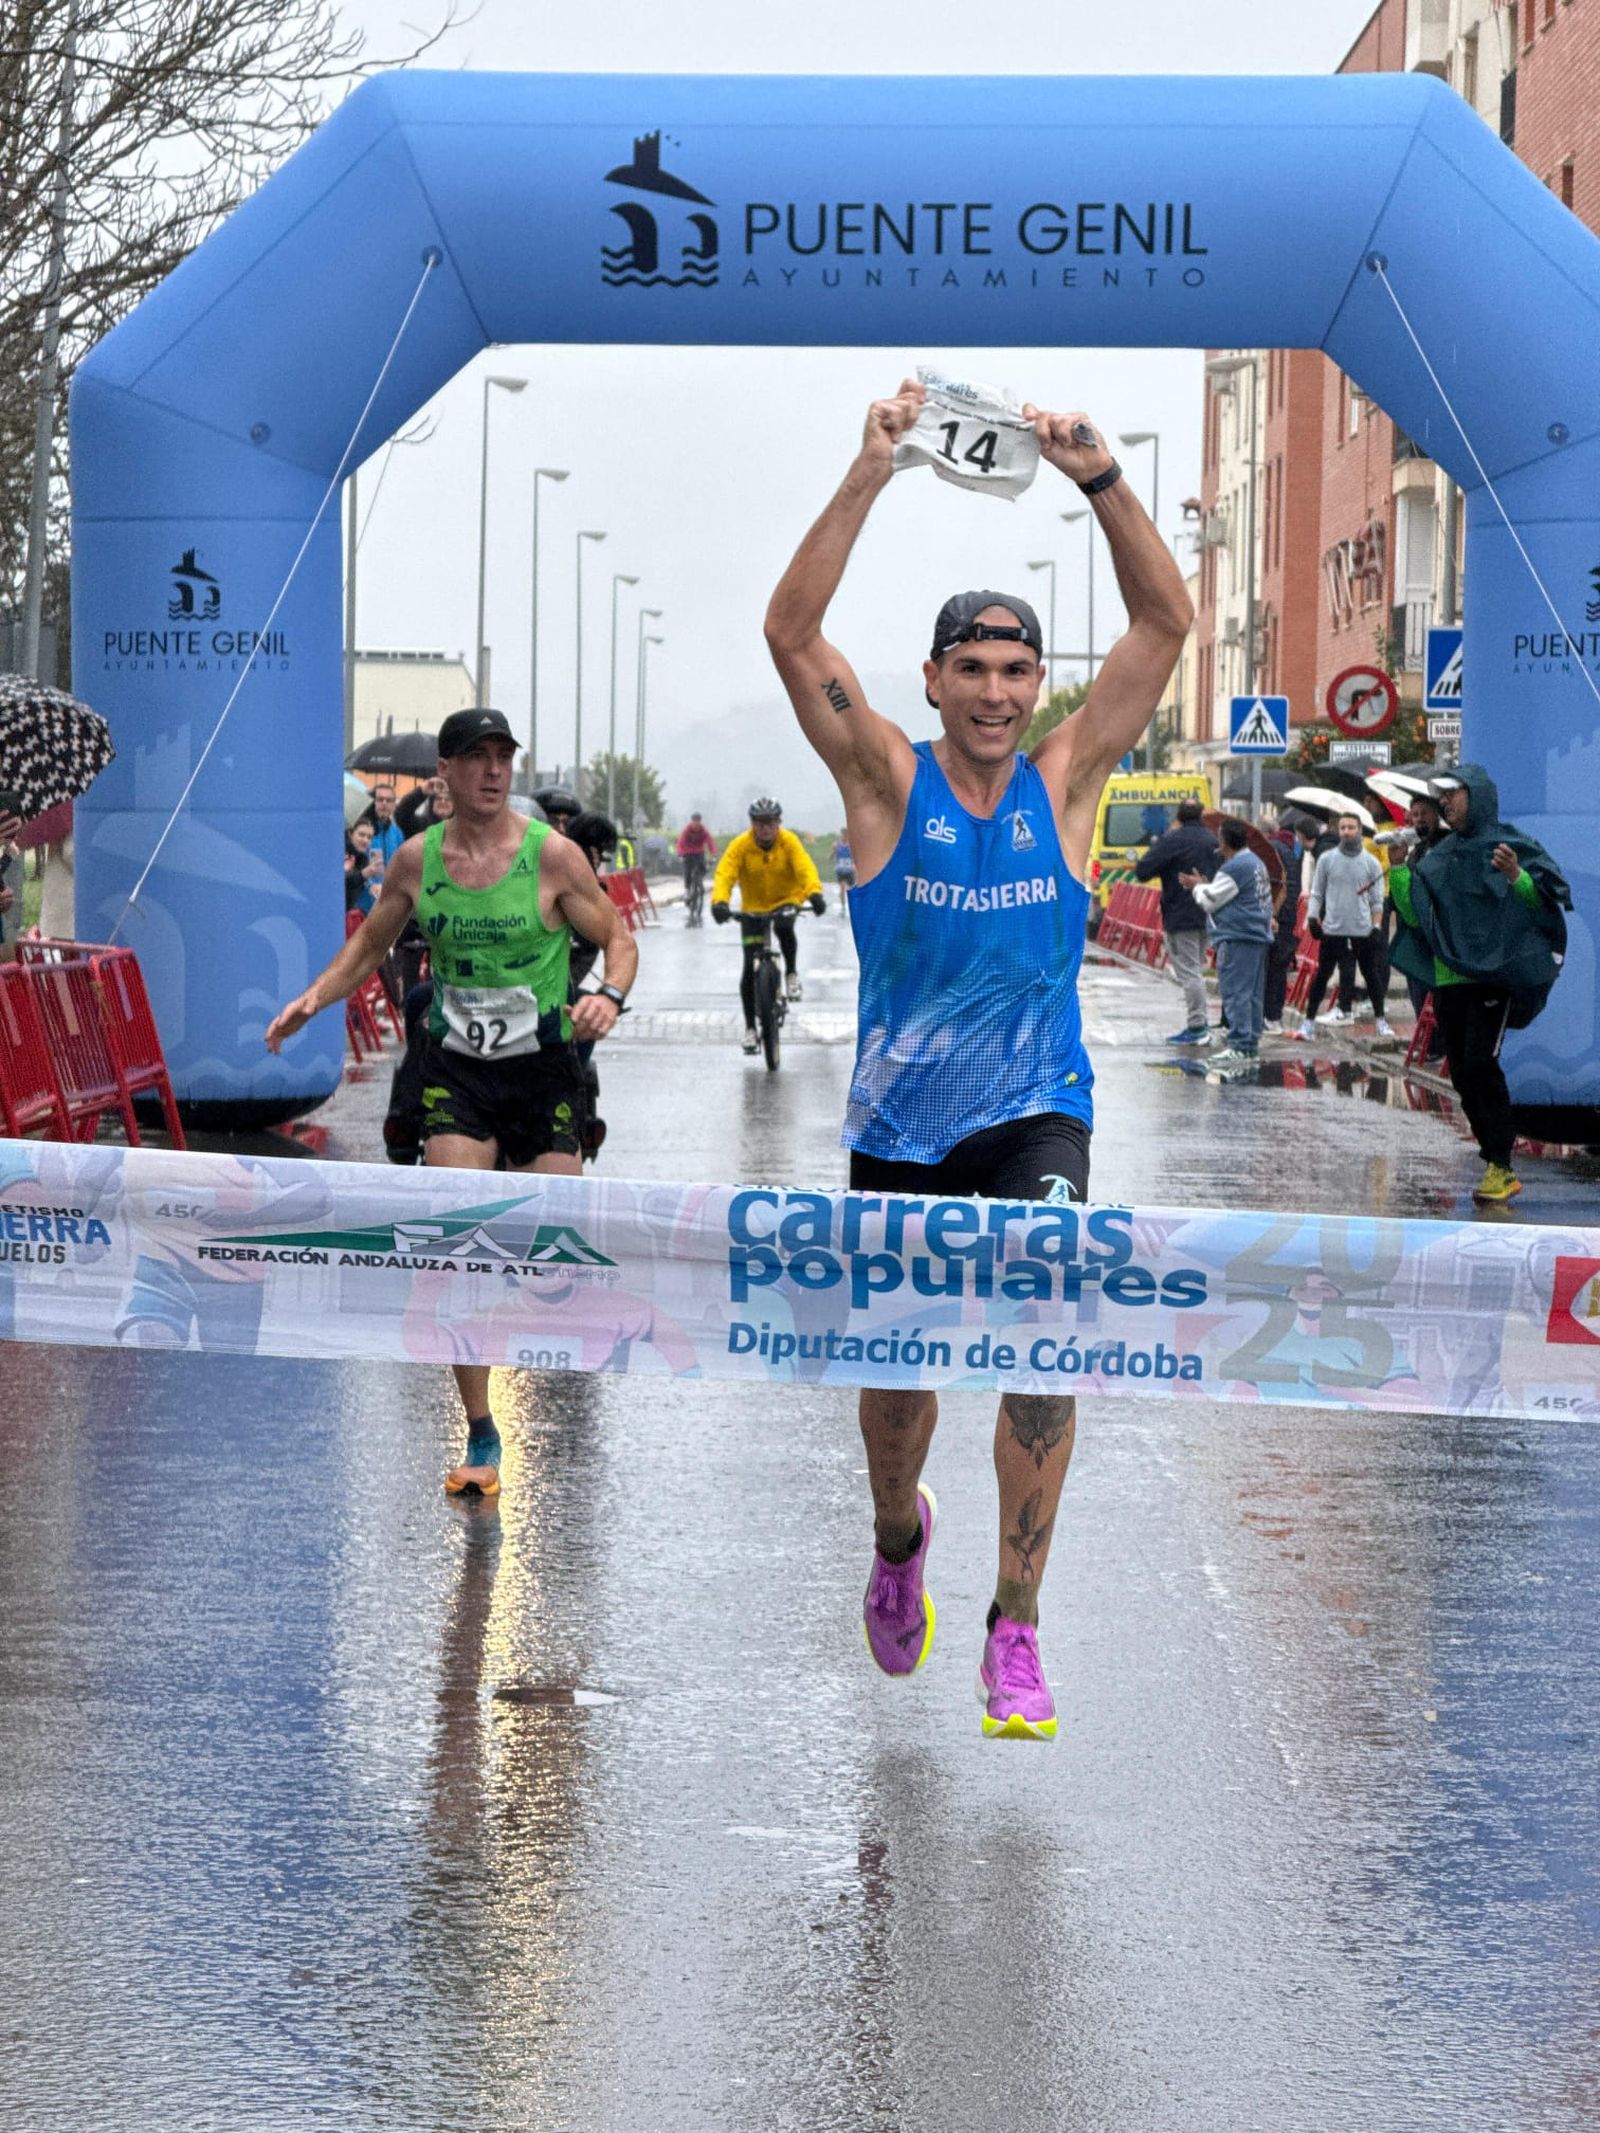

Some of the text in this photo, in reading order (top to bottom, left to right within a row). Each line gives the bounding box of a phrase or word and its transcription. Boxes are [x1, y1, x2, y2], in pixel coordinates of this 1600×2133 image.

[745, 202, 1208, 256] PUENTE GENIL
[742, 267, 1206, 288] AYUNTAMIENTO
[936, 420, 998, 474] 14
[105, 630, 291, 656] PUENTE GENIL
[104, 659, 290, 672] AYUNTAMIENTO
[1513, 662, 1600, 674] AYUN
[1110, 788, 1200, 800] AMBULANCIA
[903, 875, 1059, 912] TROTASIERRA
[452, 913, 527, 929] Fundación
[453, 928, 507, 944] Unicaja
[466, 1018, 508, 1053] 92
[0, 1204, 85, 1218] ETISMO
[728, 1189, 1134, 1270] carreras
[197, 1246, 329, 1266] FEDERACIÓN
[338, 1252, 458, 1272] ANDALUZA
[466, 1262, 493, 1274] DE
[729, 1235, 1208, 1310] populares
[728, 1321, 1203, 1382] Diputación de Córdoba
[1219, 1292, 1394, 1389] 25
[518, 1349, 572, 1369] 908
